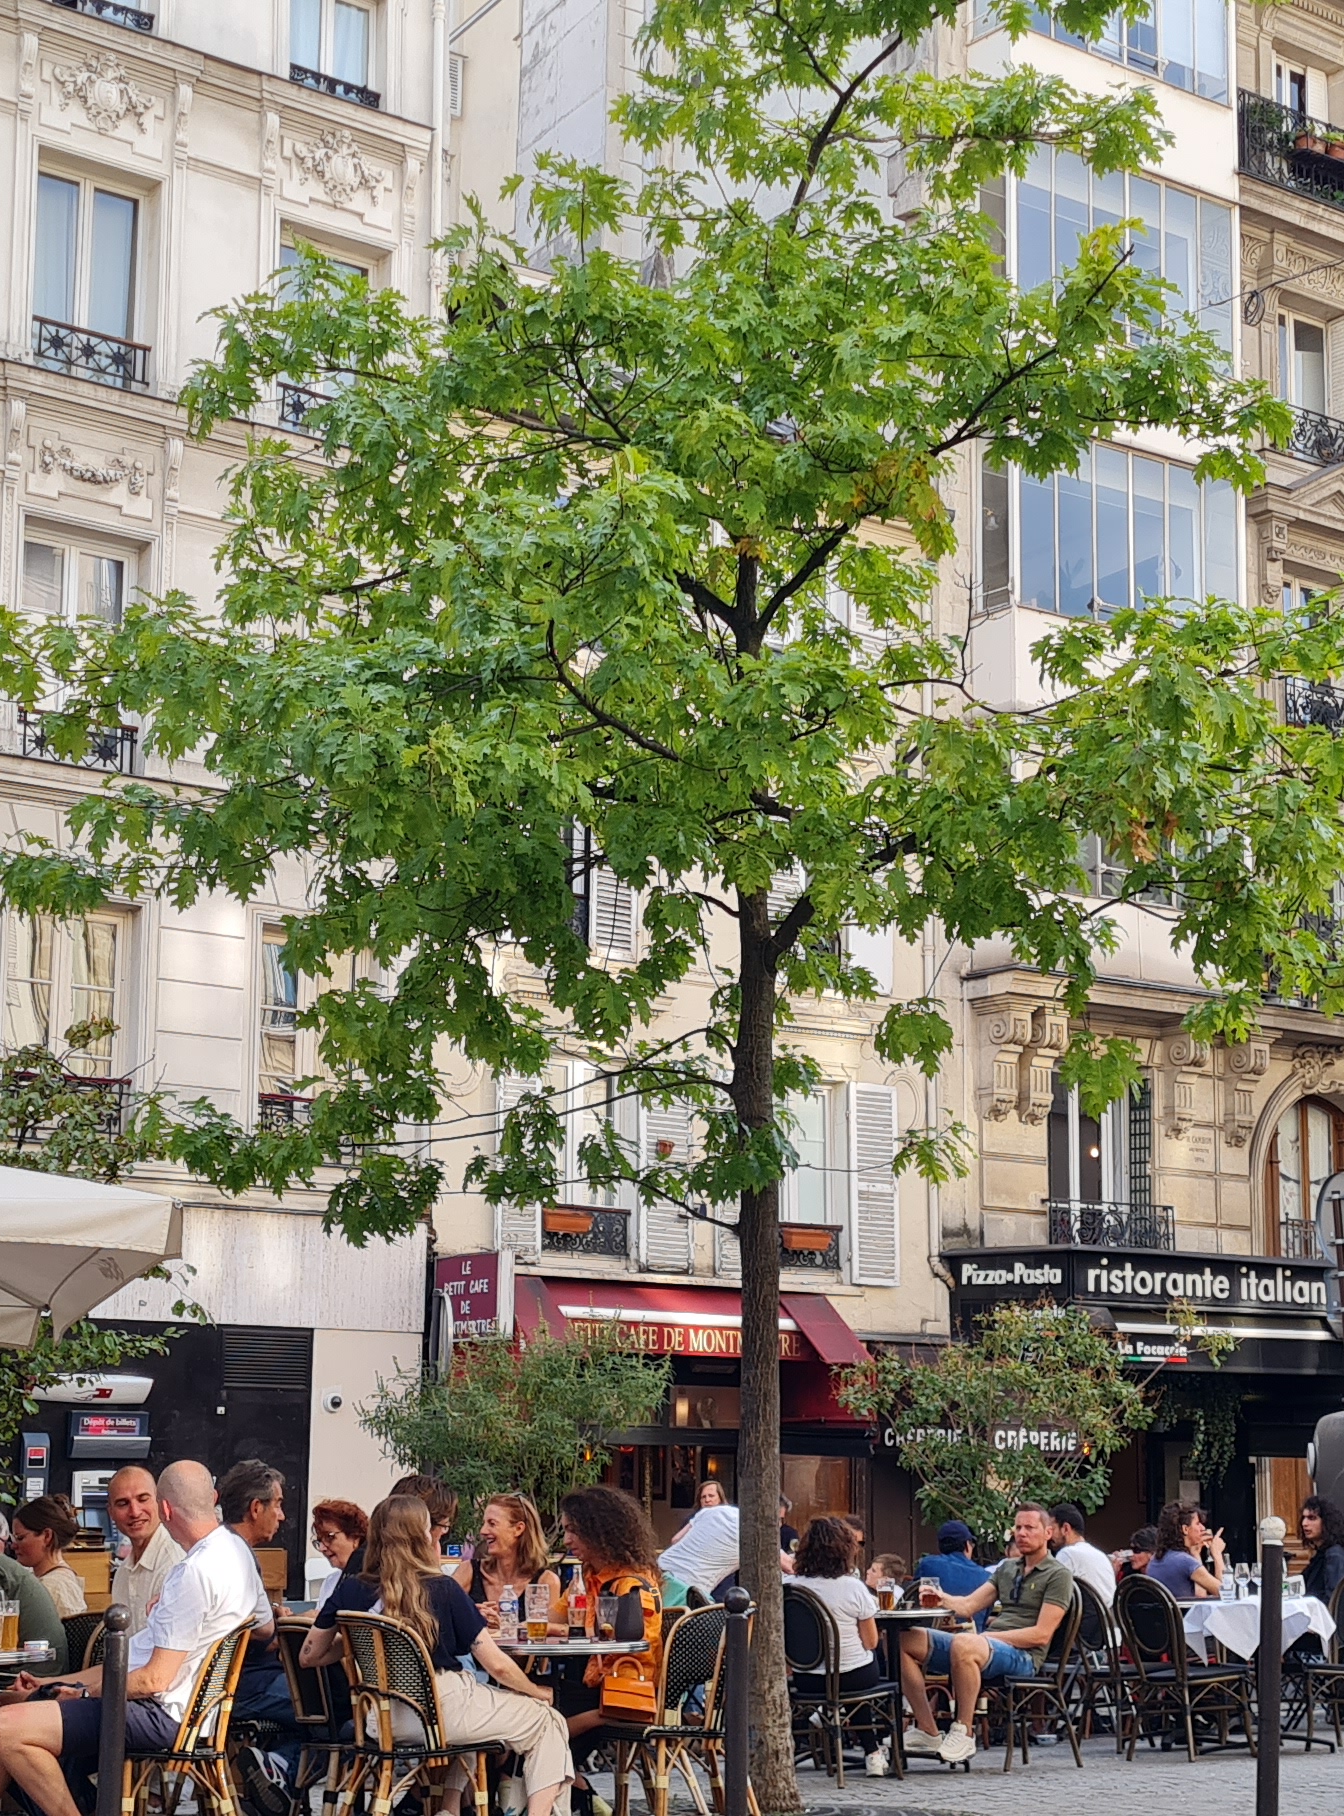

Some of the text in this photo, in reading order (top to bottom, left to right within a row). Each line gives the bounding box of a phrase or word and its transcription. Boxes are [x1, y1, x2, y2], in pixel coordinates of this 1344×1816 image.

[461, 1260, 472, 1275] LE
[1087, 1257, 1231, 1299] ristorante
[443, 1278, 489, 1296] PETIT CAFE
[460, 1300, 471, 1314] DE
[615, 1322, 659, 1350] CAFE
[663, 1327, 685, 1351] DE
[106, 1418, 115, 1426] de
[116, 1418, 137, 1427] billets
